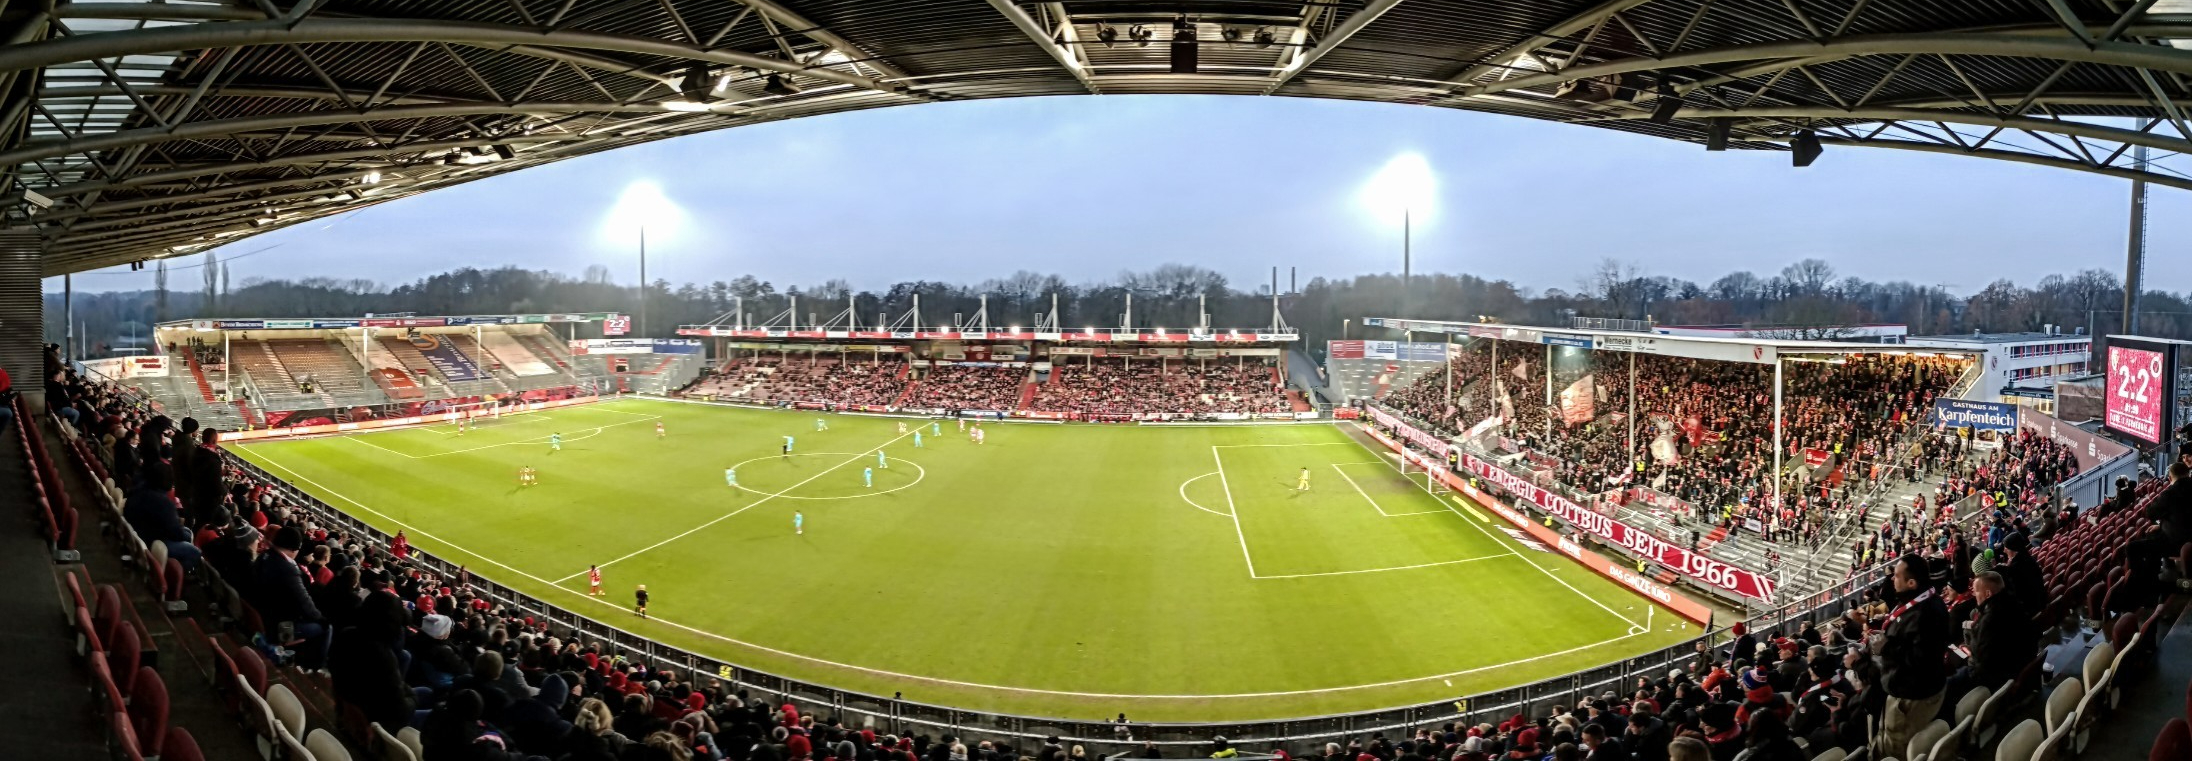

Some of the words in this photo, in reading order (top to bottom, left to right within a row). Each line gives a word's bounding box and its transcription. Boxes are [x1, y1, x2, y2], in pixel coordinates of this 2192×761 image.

[609, 319, 625, 328] 2:2
[2118, 365, 2150, 403] 2:2
[1952, 401, 1987, 410] GASTHAUS
[1938, 406, 2015, 427] Karpfenteich
[1488, 467, 1538, 503] ENERGIE
[1544, 493, 1613, 539] COTTBUS
[1623, 526, 1668, 562] SEIT
[1679, 549, 1738, 590] 1966
[1609, 565, 1624, 580] DAS
